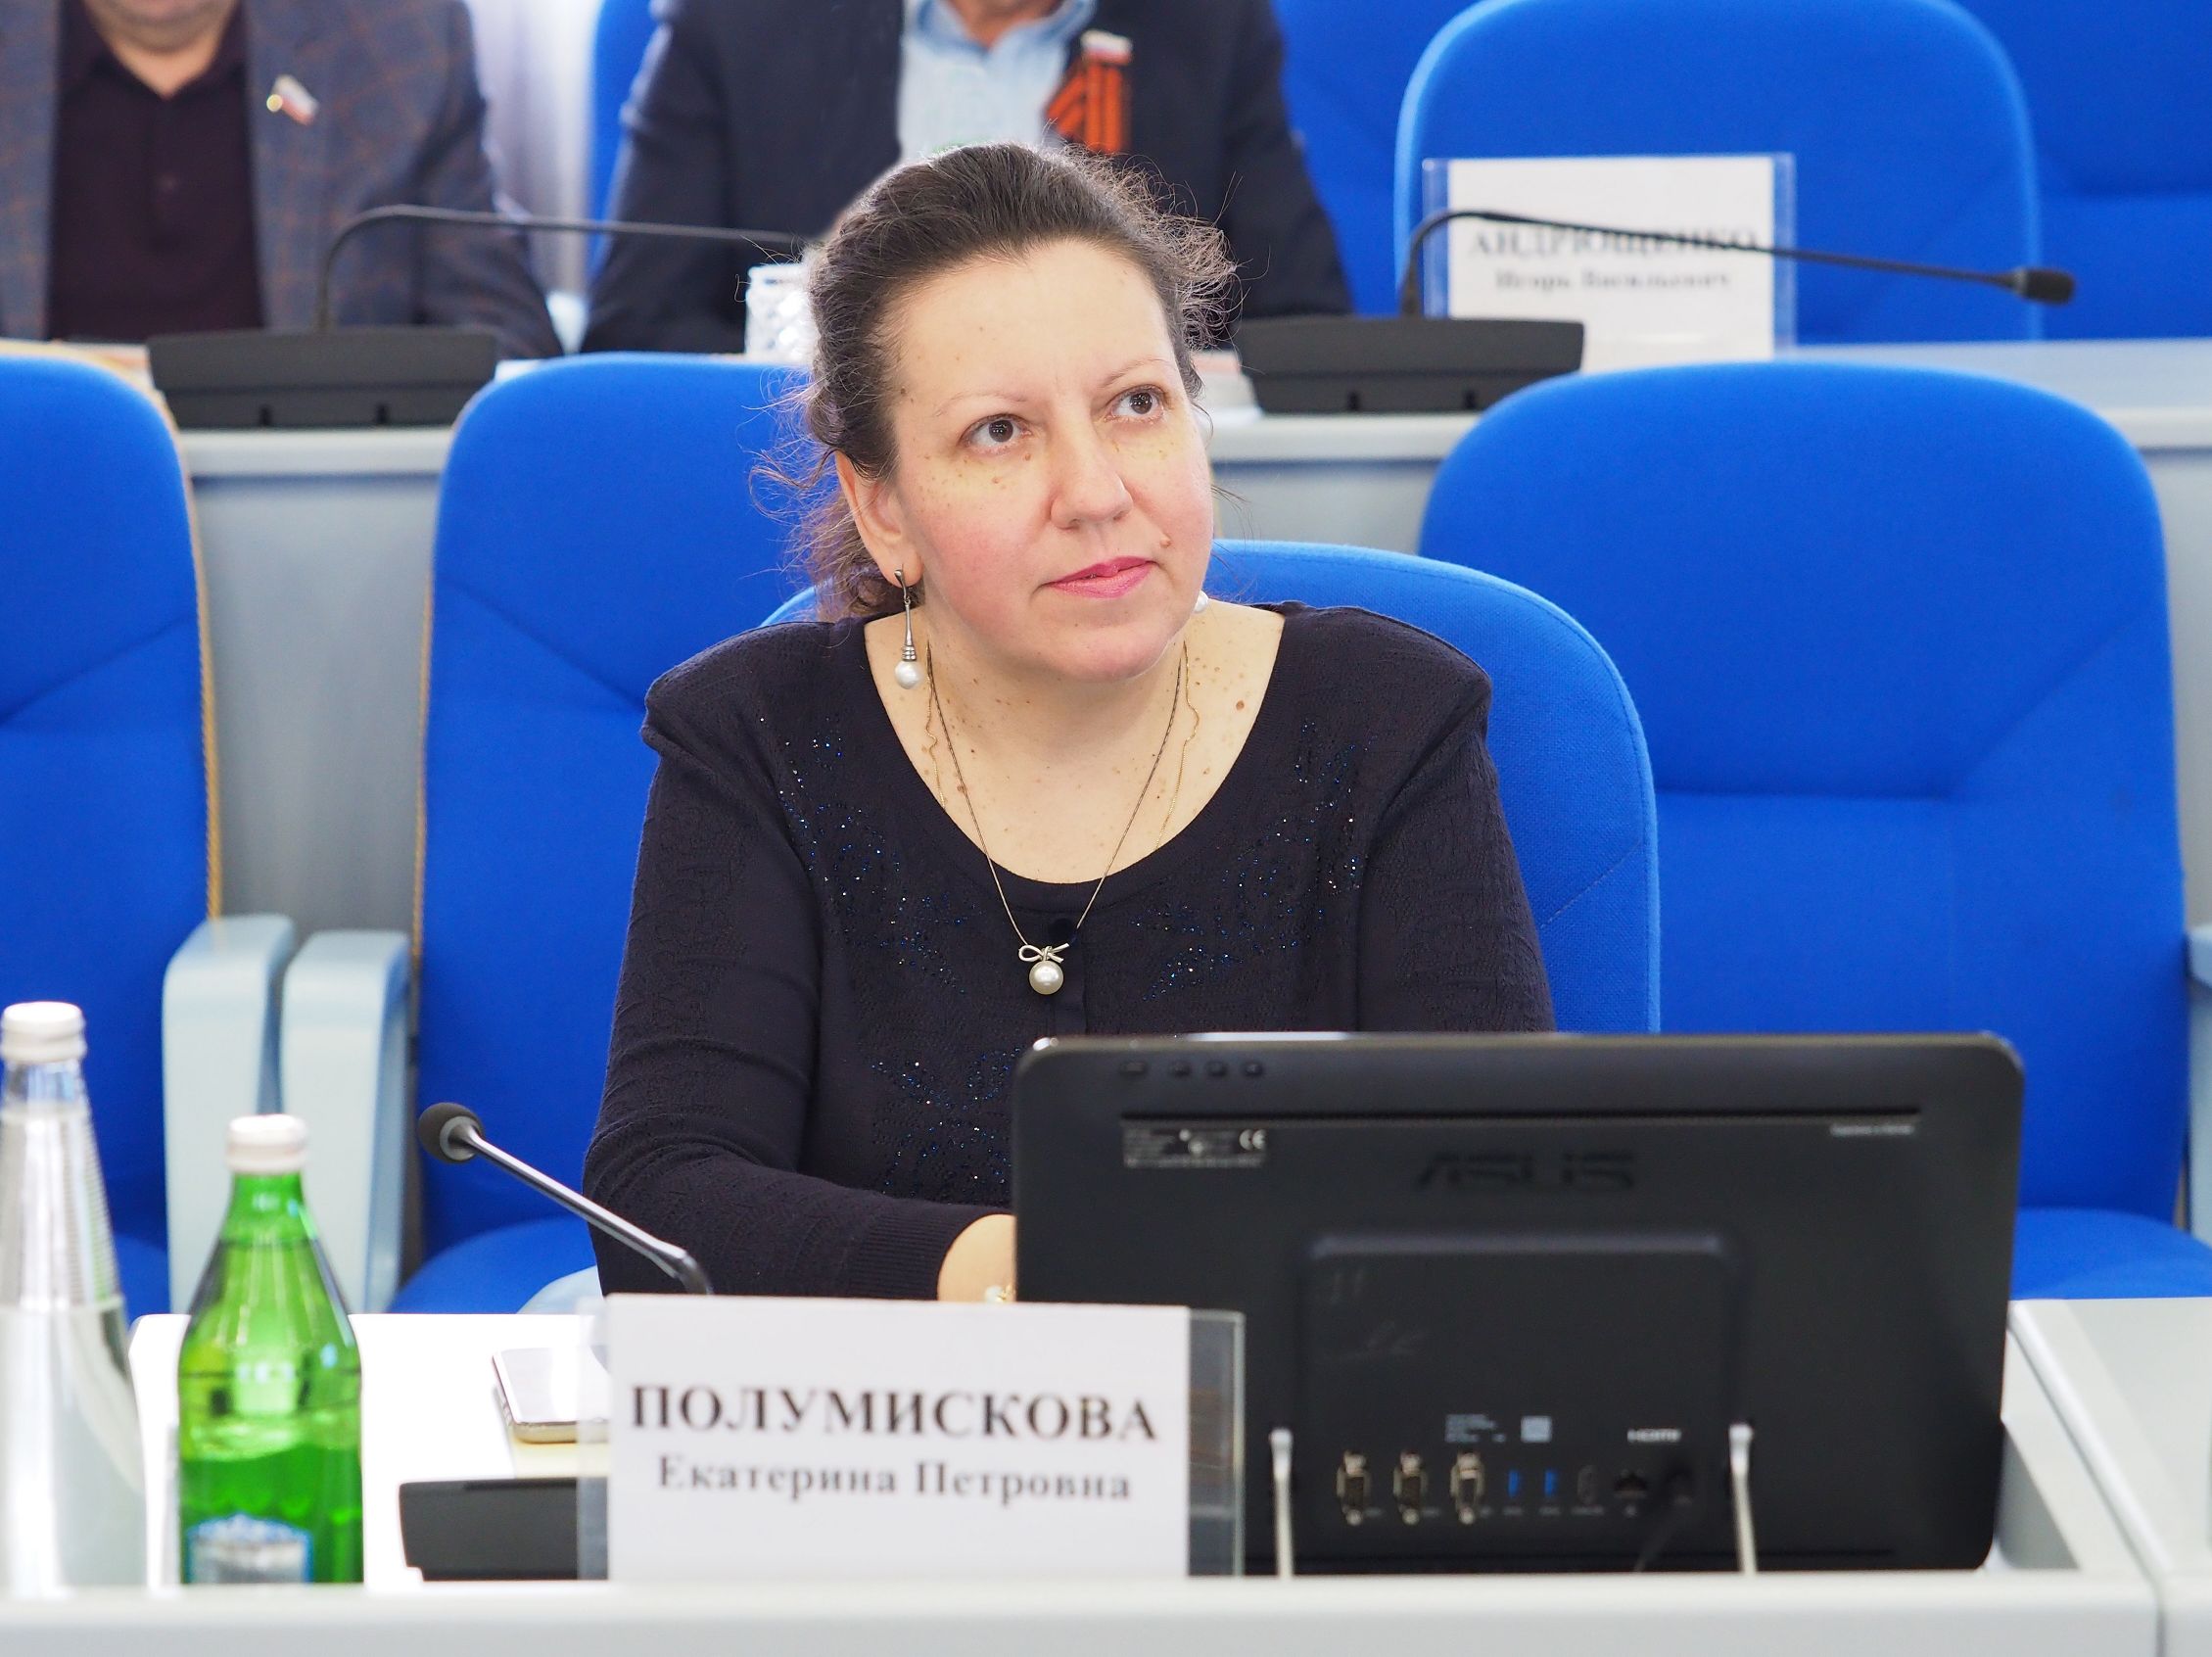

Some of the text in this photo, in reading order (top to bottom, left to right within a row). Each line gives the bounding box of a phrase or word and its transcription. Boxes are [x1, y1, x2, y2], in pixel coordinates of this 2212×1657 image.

[1416, 1152, 1635, 1192] ASUS
[632, 1384, 1157, 1442] ПОЛУМИСКОВА
[658, 1454, 1131, 1507] Екатерина Петровна
